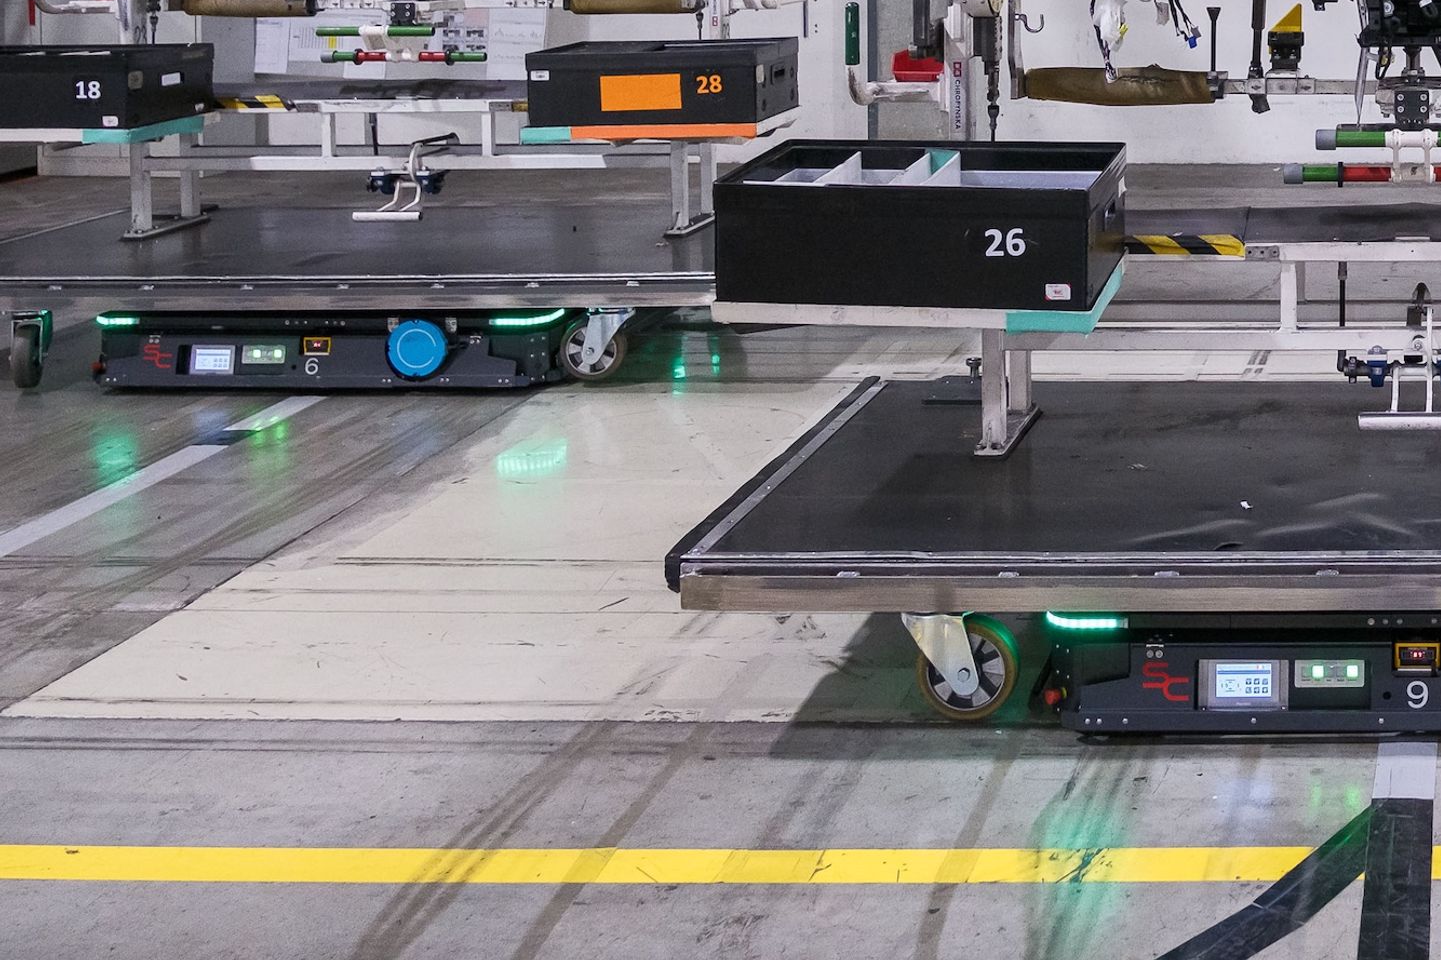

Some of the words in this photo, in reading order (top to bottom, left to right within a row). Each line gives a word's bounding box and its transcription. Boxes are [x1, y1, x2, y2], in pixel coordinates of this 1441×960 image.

[75, 80, 101, 100] 18
[696, 74, 723, 94] 28
[984, 227, 1026, 257] 26
[304, 357, 319, 376] 6
[1406, 680, 1429, 709] 9
